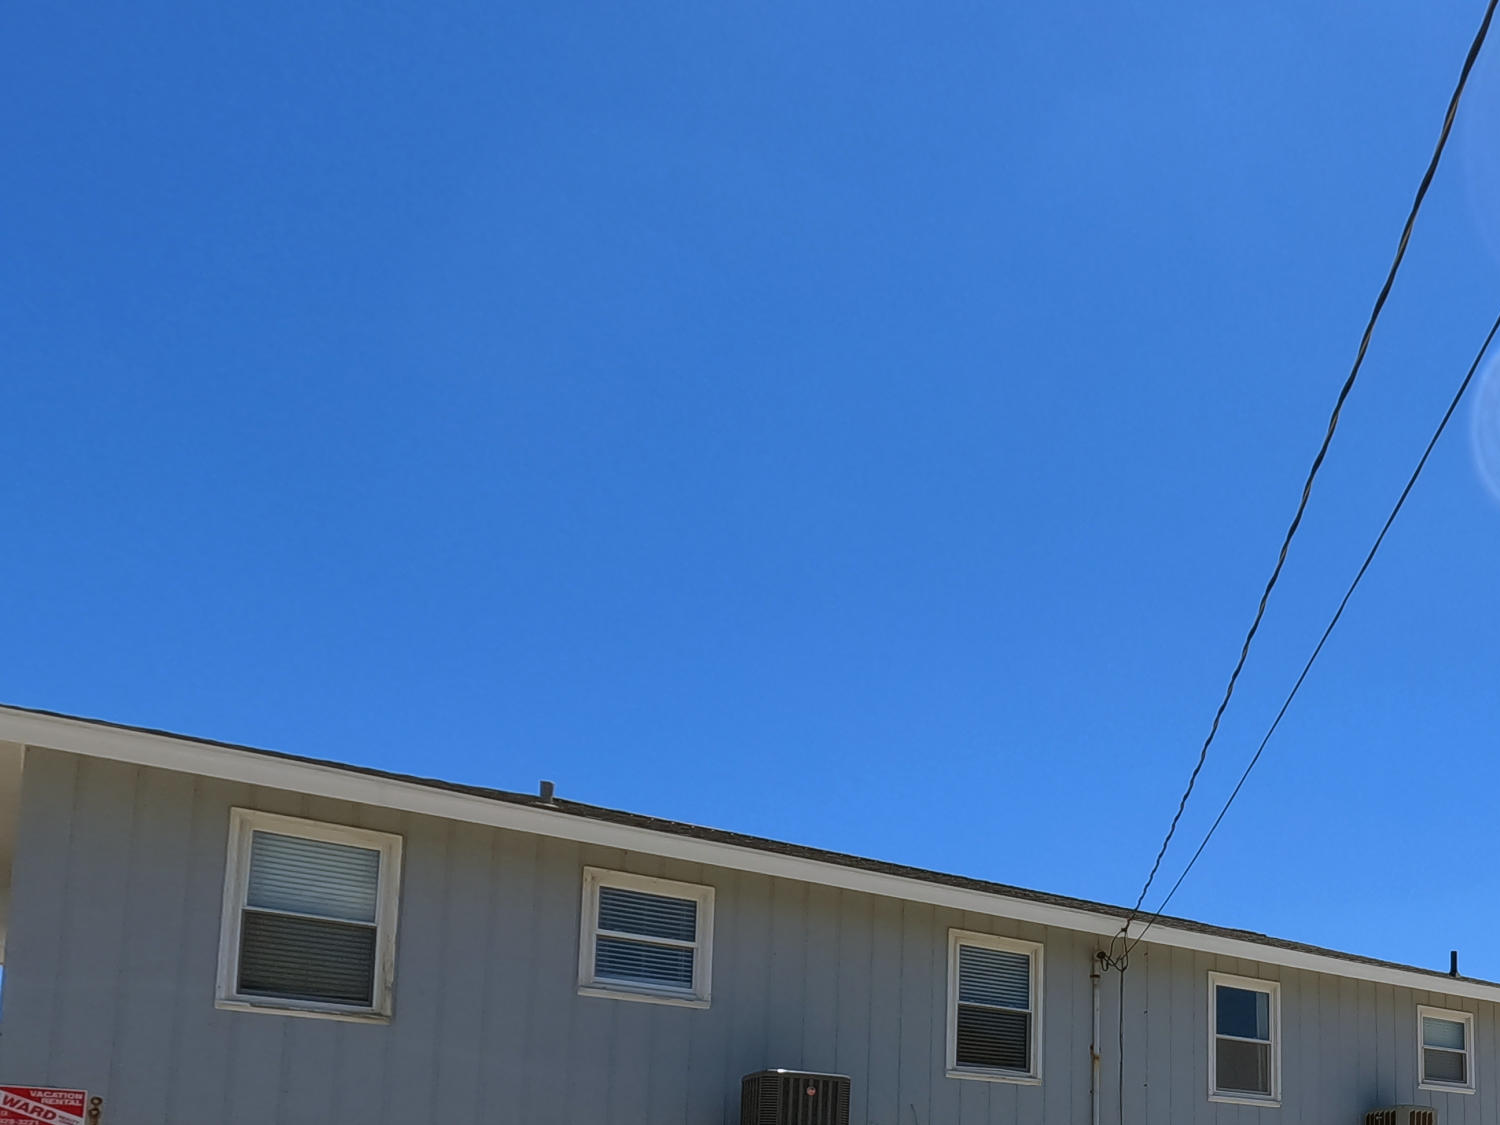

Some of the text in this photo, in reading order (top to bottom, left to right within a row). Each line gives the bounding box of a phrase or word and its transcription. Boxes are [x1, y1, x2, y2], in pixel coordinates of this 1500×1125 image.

[30, 1090, 83, 1099] VACATION
[41, 1098, 82, 1106] RENTAL
[2, 1095, 57, 1120] WARD
